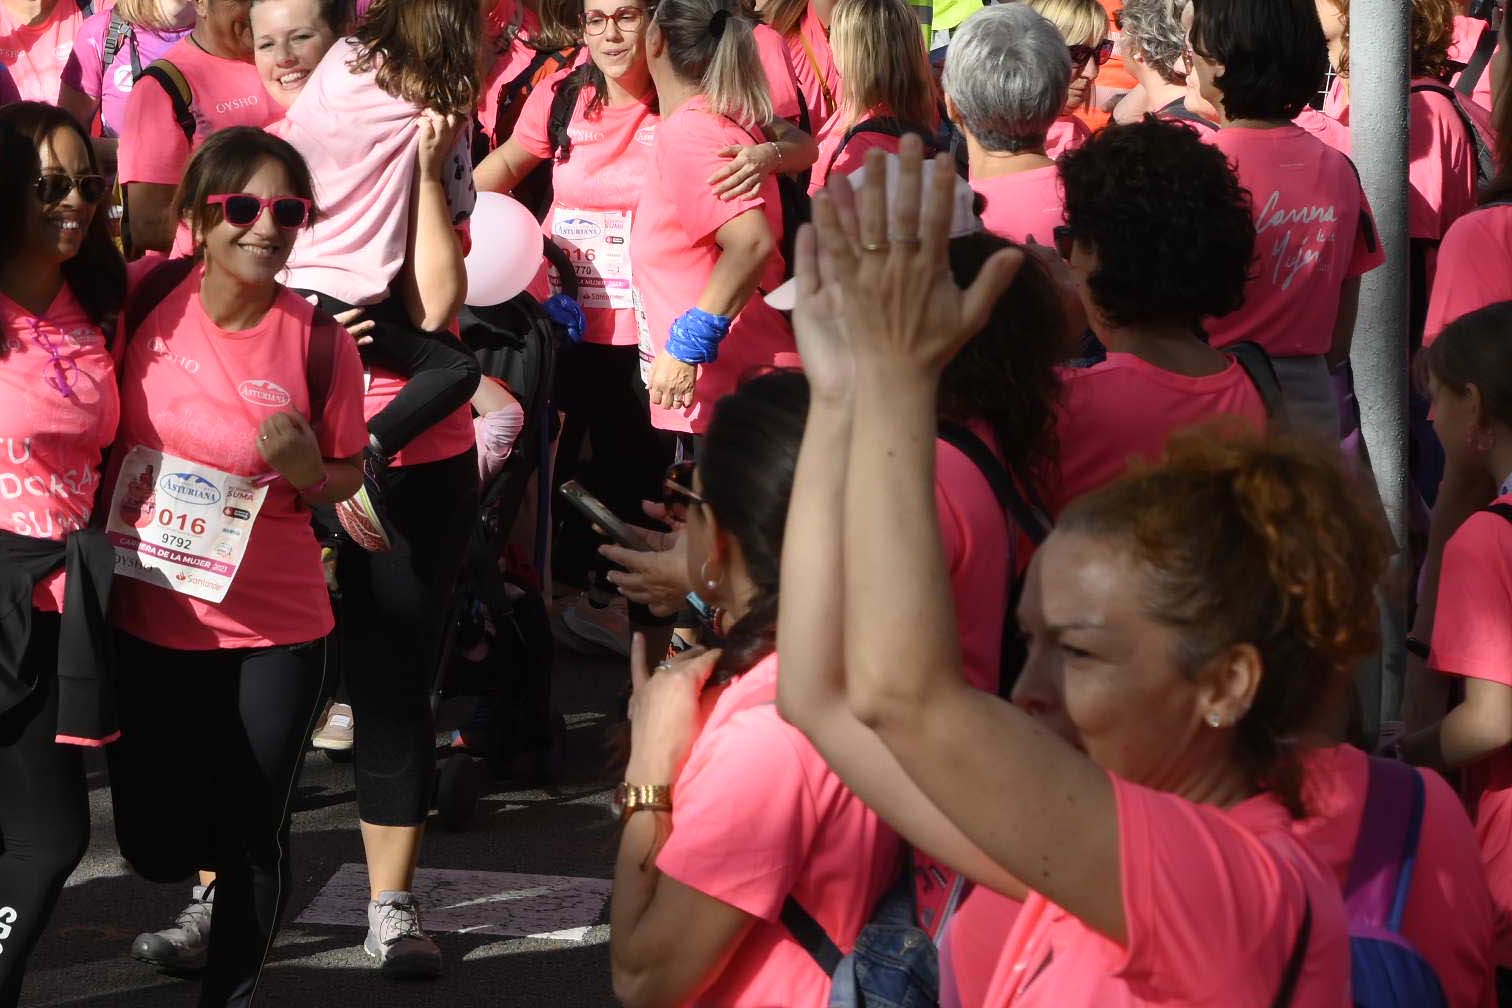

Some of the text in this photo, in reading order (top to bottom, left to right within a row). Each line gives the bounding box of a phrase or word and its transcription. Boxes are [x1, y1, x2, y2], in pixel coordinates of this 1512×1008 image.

[215, 95, 259, 114] OYSHO
[573, 265, 592, 275] 770
[163, 478, 217, 503] ASTURIANA
[158, 507, 207, 537] 016
[161, 533, 192, 551] 9792
[157, 548, 170, 559] DE
[171, 551, 181, 562] LA
[183, 554, 212, 570] MUJER
